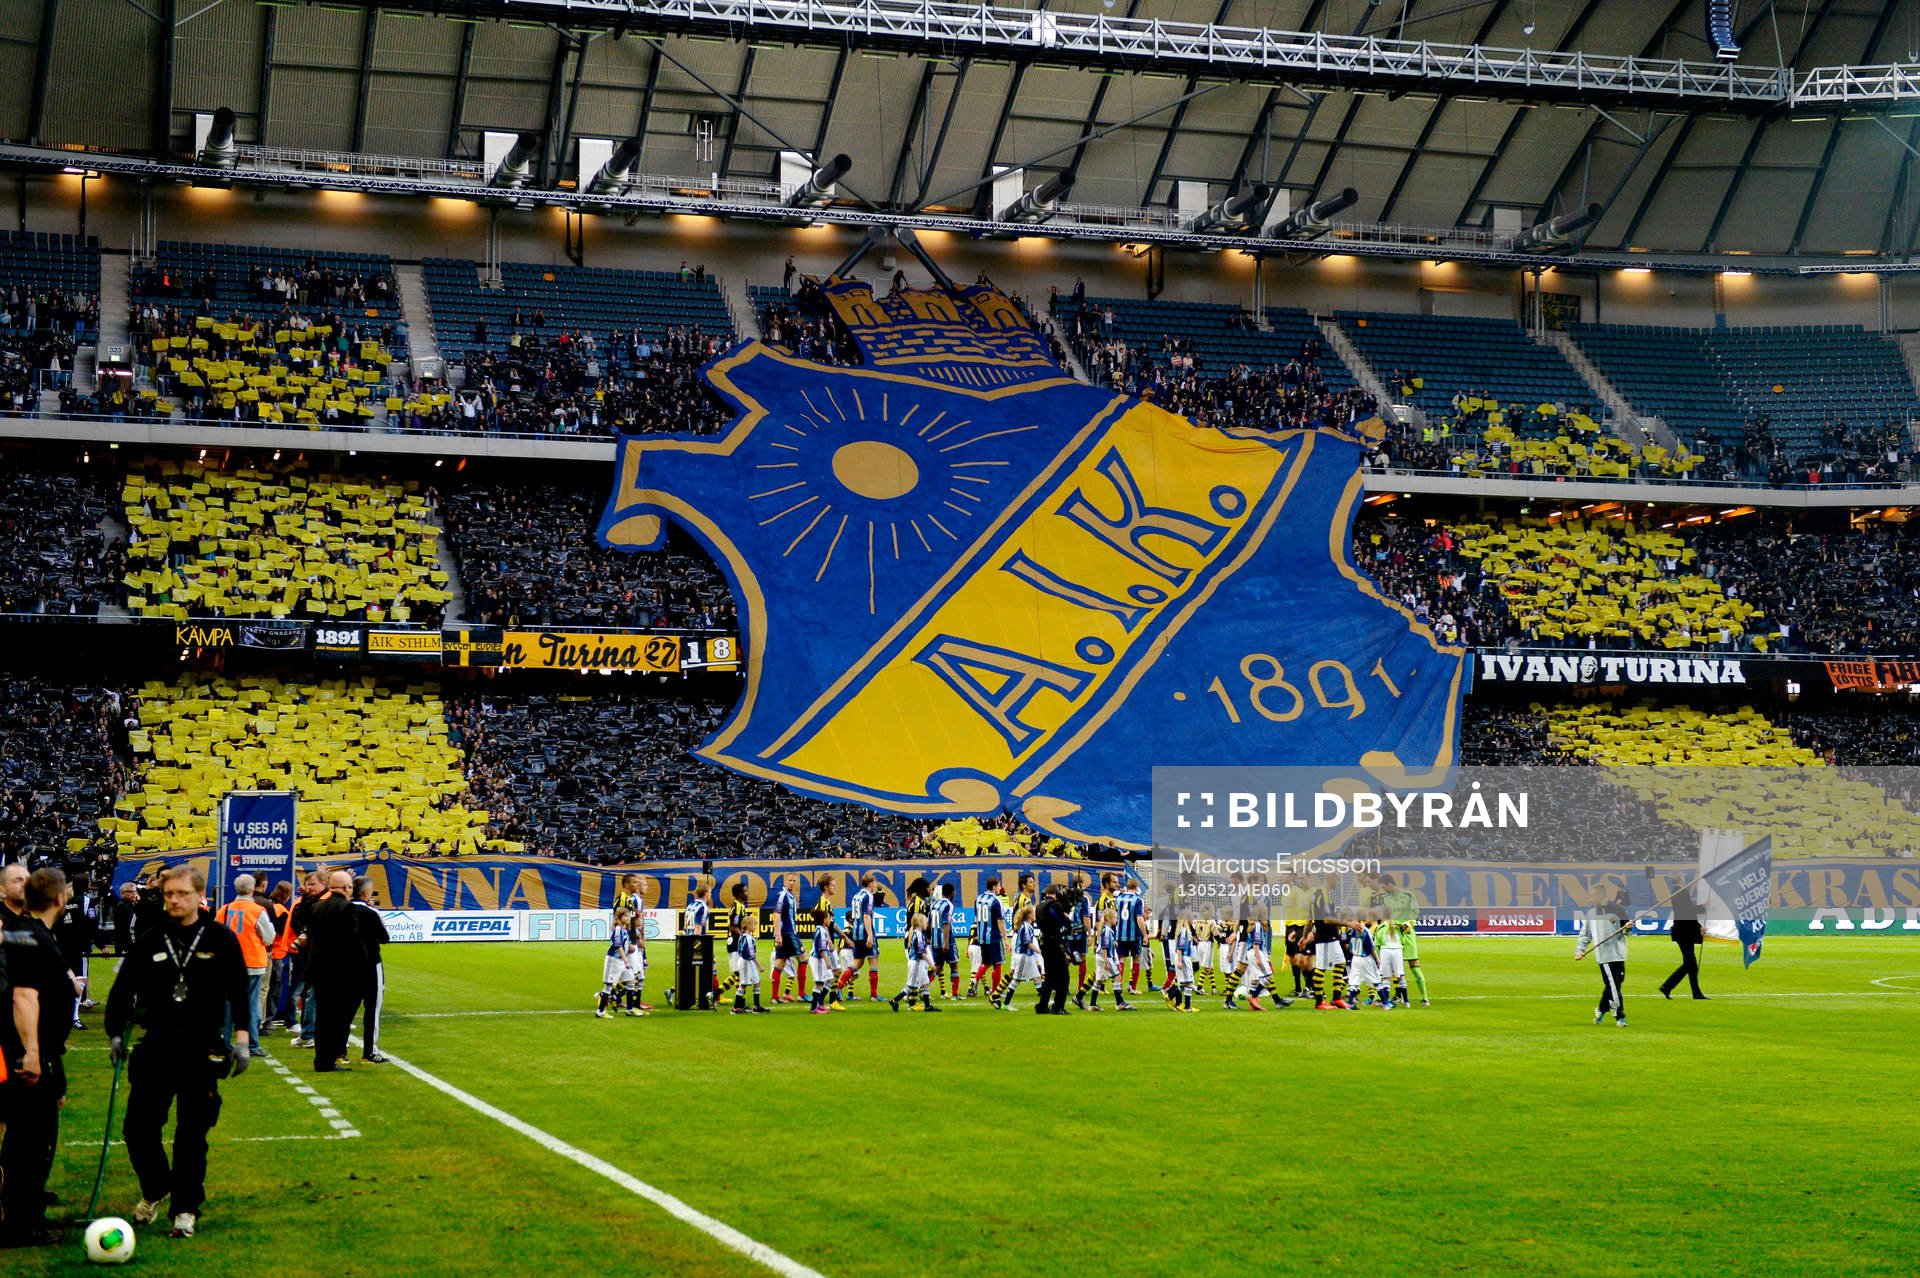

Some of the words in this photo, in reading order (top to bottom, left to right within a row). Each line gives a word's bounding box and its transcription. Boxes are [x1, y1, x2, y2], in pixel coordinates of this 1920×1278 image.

[176, 626, 234, 646] KÄMPA
[316, 630, 360, 644] 1891
[371, 636, 394, 649] AIK
[400, 635, 442, 649] STHLM
[539, 633, 641, 668] Turina
[645, 638, 677, 667] 27
[1481, 655, 1580, 683] IVAN
[1600, 657, 1746, 684] TURINA
[233, 822, 245, 834] VI
[247, 822, 269, 834] SES
[272, 819, 288, 834] PÅ
[237, 834, 282, 850] LÖRDAG
[1738, 867, 1767, 890] HELA
[1734, 880, 1770, 910] SVERIG
[1121, 901, 1130, 920] 6
[227, 909, 244, 933] 71
[386, 923, 423, 931] rodukter
[432, 920, 512, 932] KATEPAL
[528, 913, 661, 940] Flins
[1415, 914, 1469, 926] RISTADS
[1488, 914, 1544, 926] KANSAS
[408, 933, 423, 941] AB
